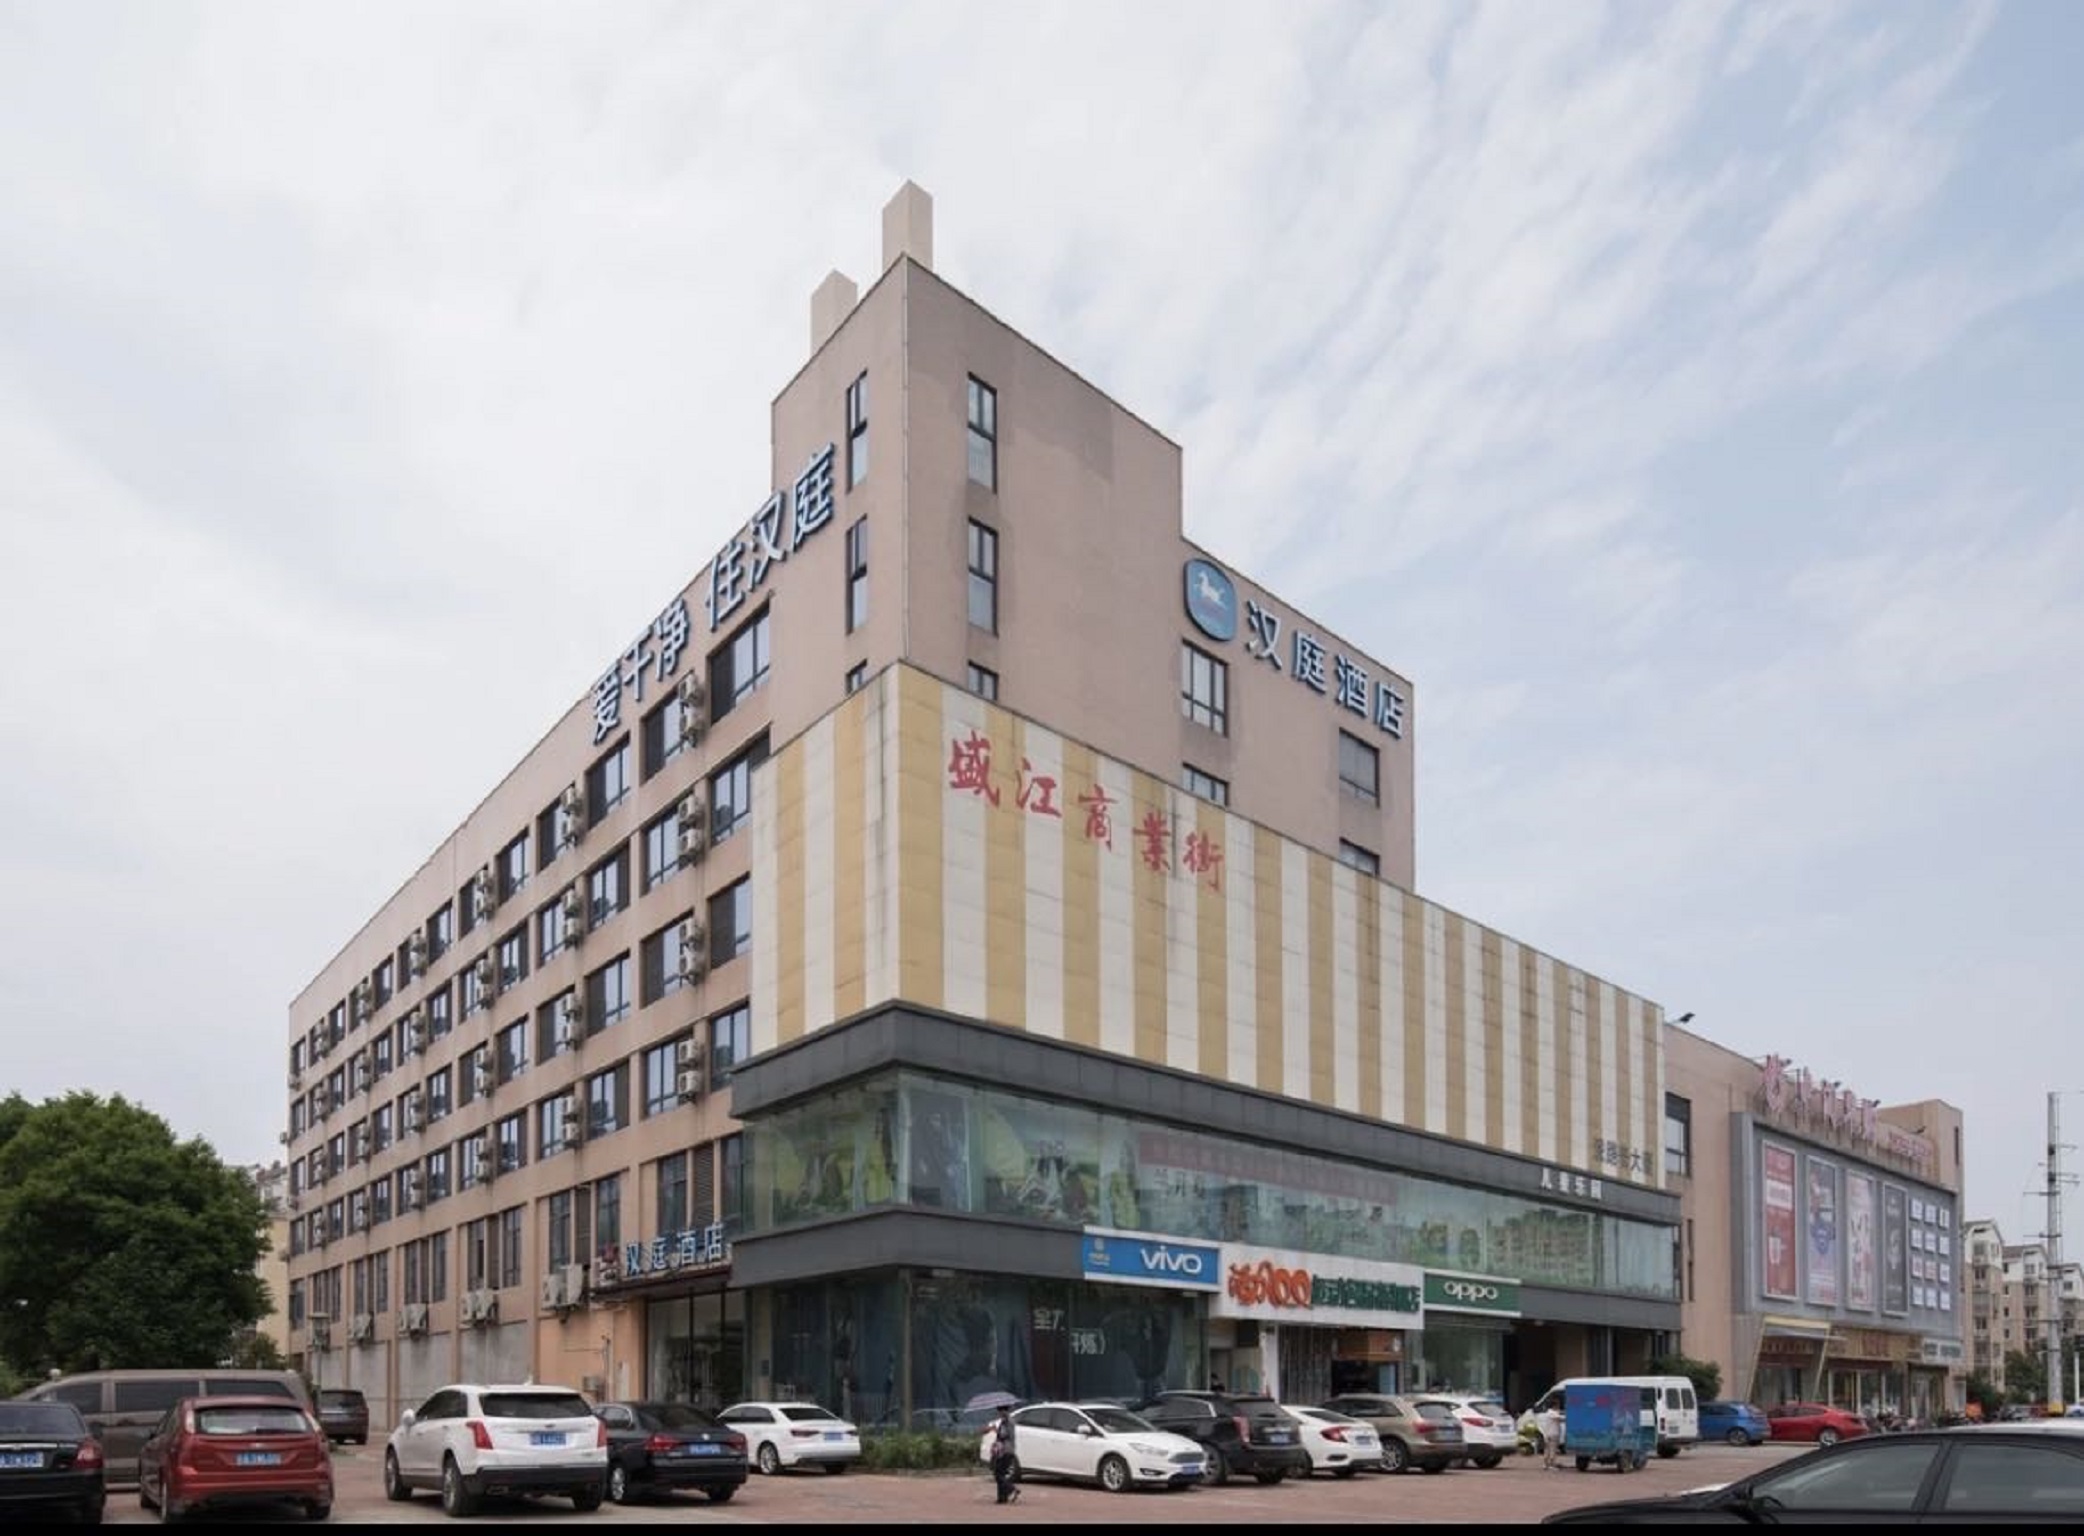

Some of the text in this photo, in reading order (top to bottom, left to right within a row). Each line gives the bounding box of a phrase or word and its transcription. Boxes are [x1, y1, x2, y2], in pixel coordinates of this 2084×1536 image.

[591, 442, 836, 746] 爱干净 住汉庭
[1246, 599, 1406, 740] 汉庭酒店
[1140, 1245, 1203, 1275] vivo
